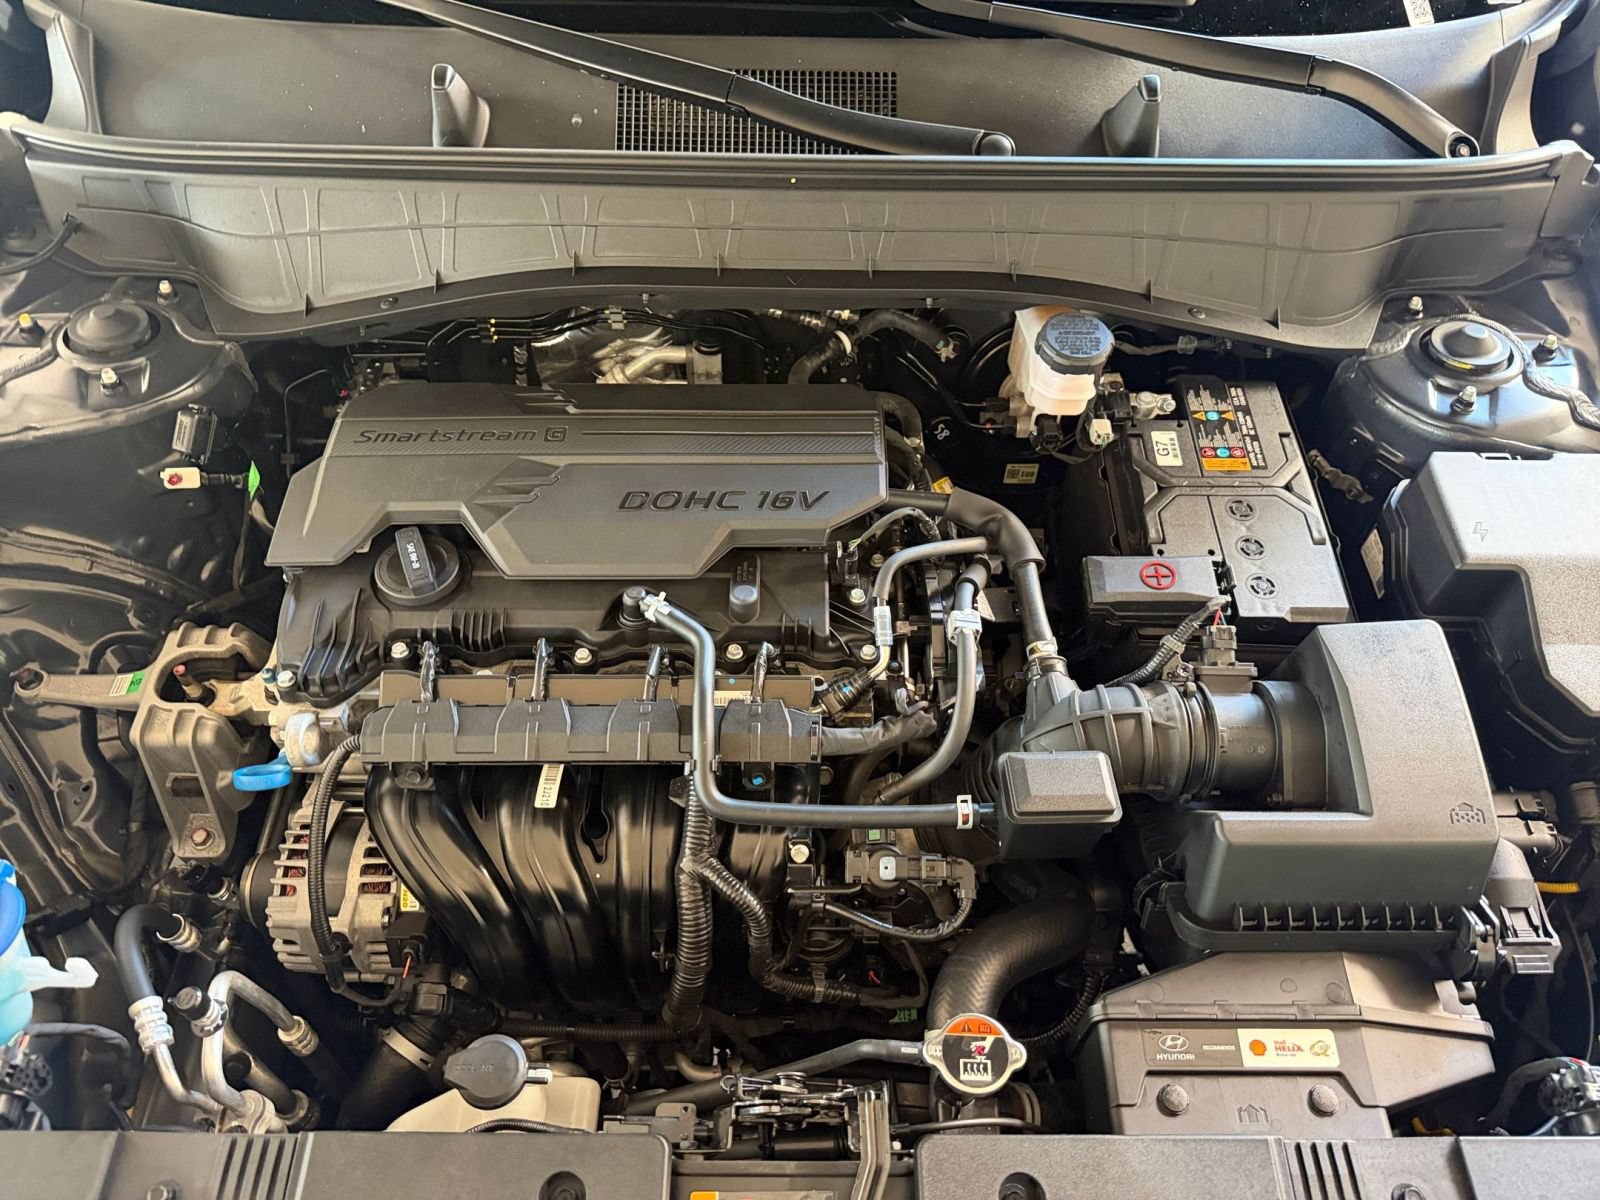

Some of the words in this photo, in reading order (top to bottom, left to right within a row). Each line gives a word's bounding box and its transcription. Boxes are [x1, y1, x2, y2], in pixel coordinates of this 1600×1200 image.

[354, 428, 537, 443] Smartstream
[1155, 440, 1171, 457] G7
[617, 490, 747, 512] DOHC
[757, 490, 831, 511] 16V
[1275, 1043, 1304, 1052] HELIX
[1157, 1053, 1196, 1061] HYUNDAI
